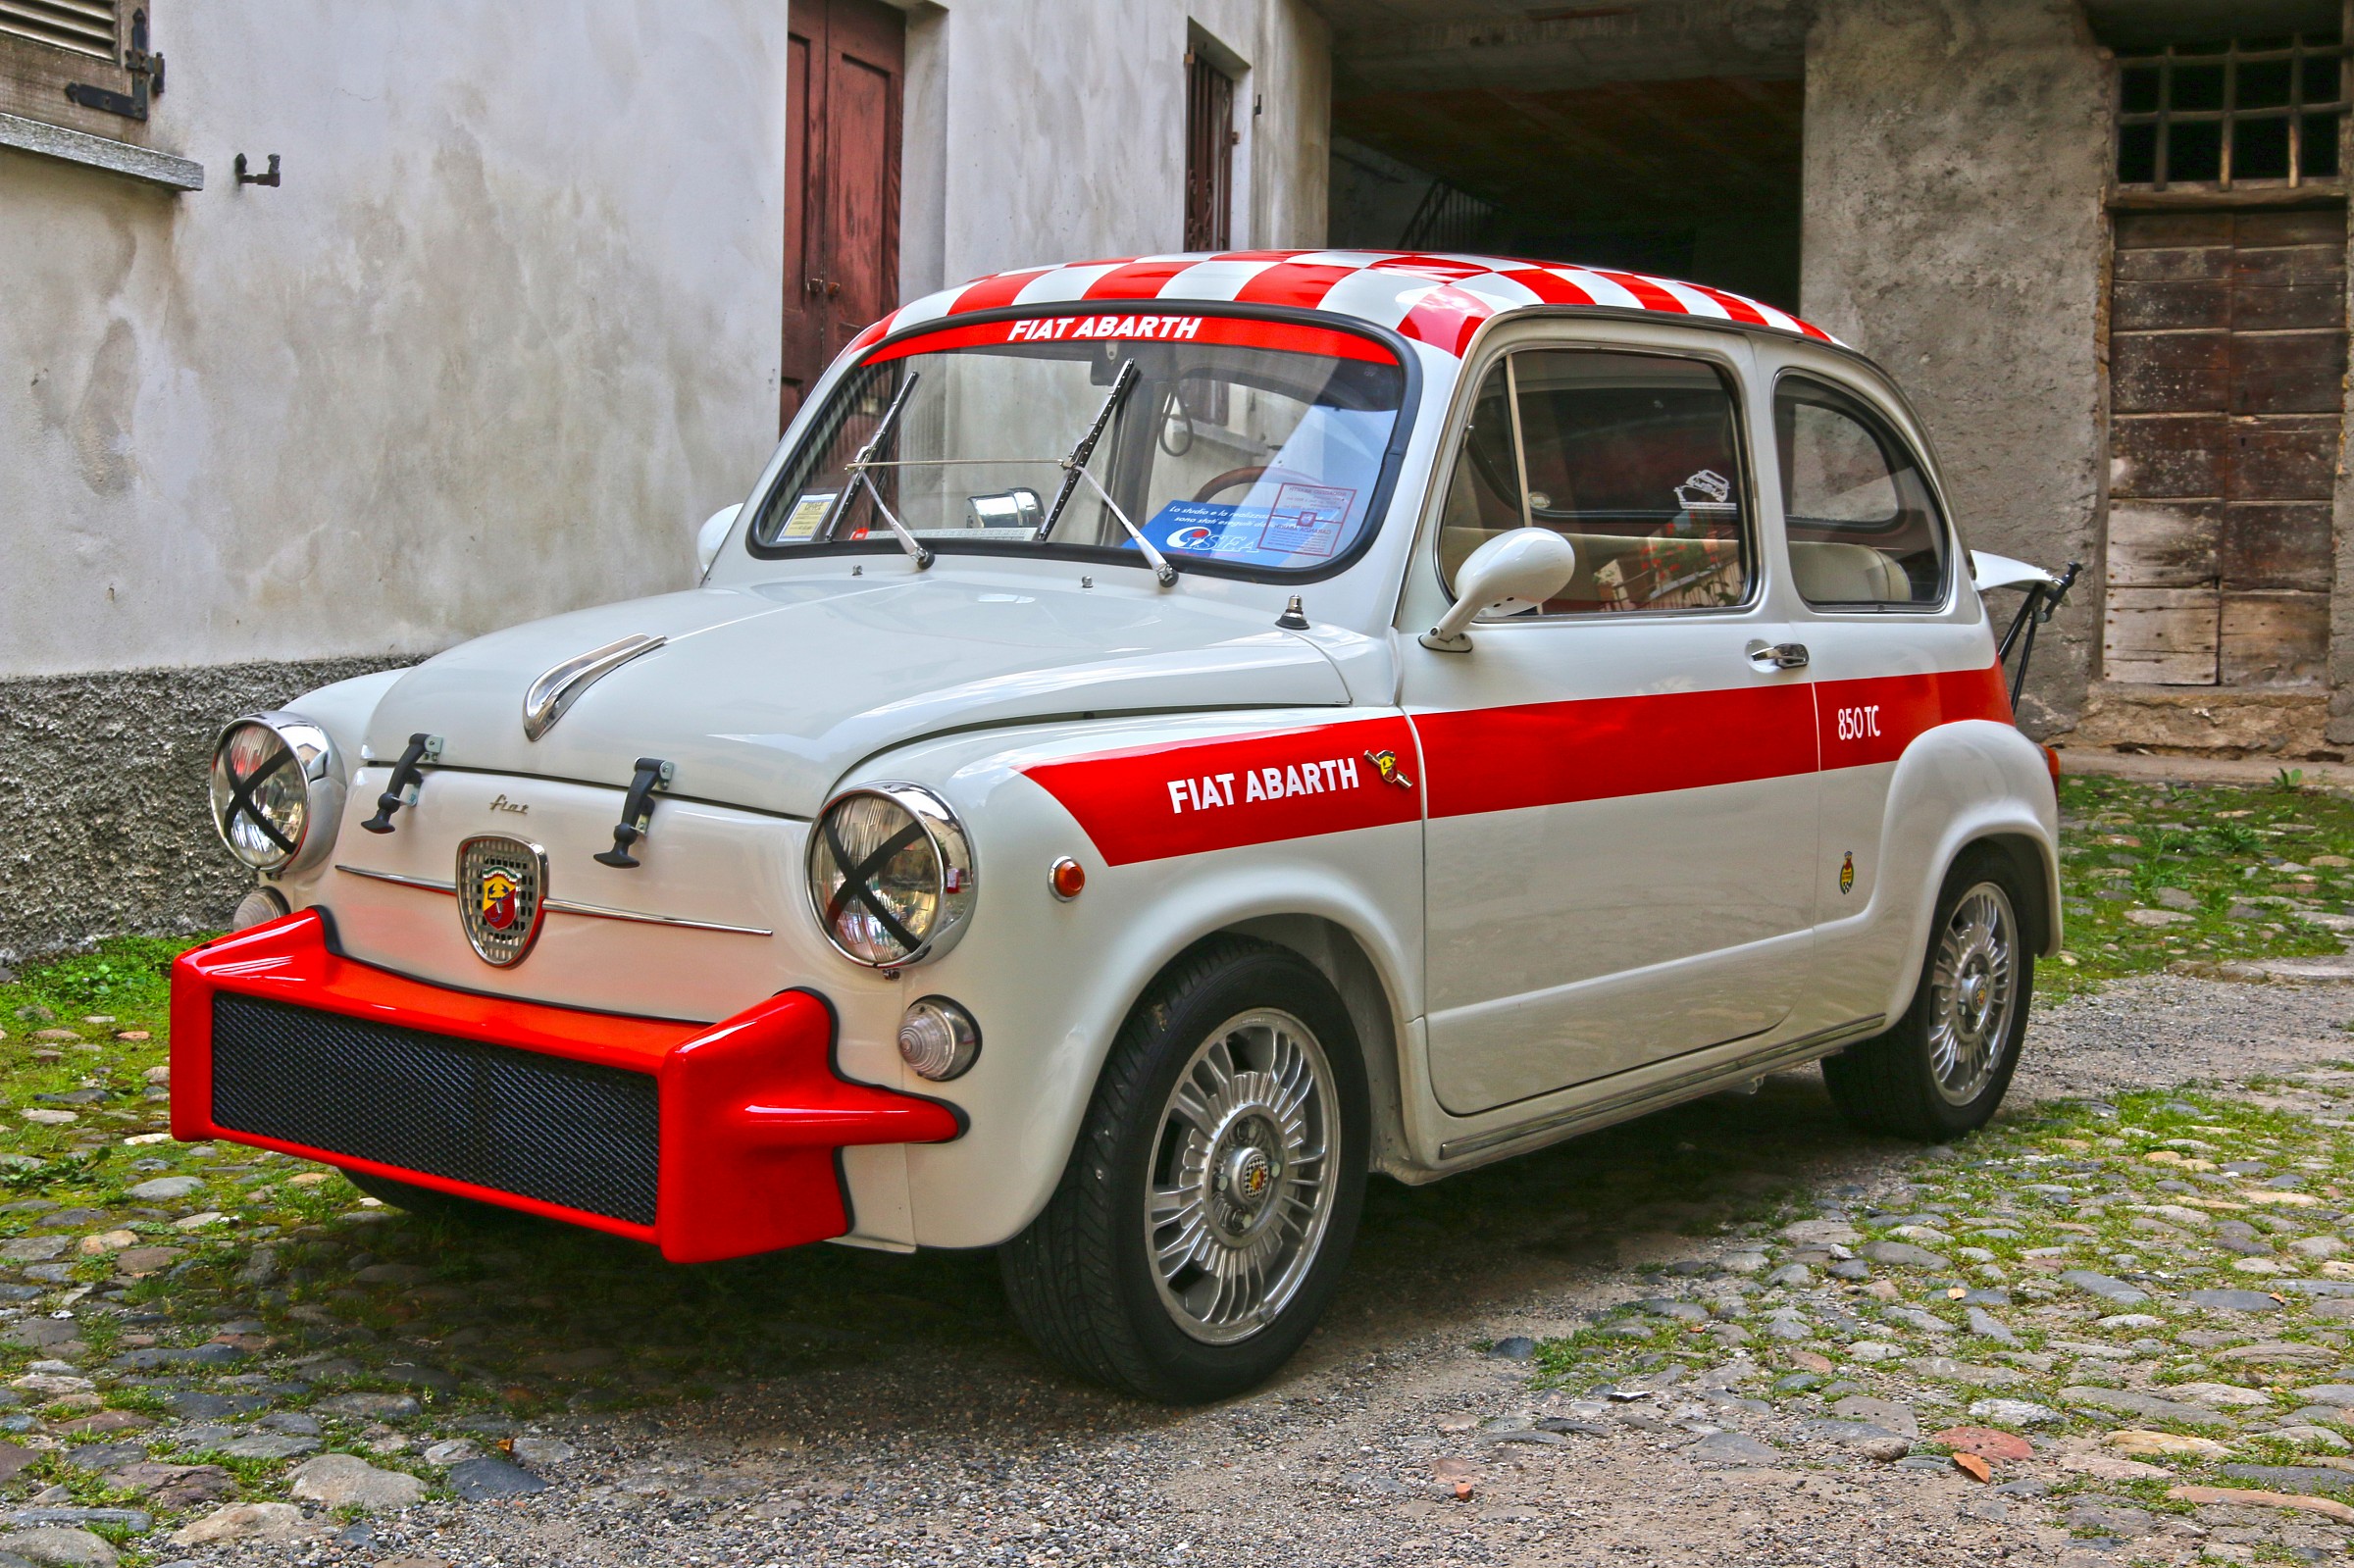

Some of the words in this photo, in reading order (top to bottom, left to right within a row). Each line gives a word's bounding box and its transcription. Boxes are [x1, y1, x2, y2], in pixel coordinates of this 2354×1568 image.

[1006, 318, 1075, 341] FIAT
[1071, 316, 1203, 339] ABARTH
[1182, 507, 1209, 516] studio
[1167, 773, 1236, 814] FIAT
[1246, 757, 1359, 803] ABARTH
[489, 793, 529, 814] fiat
